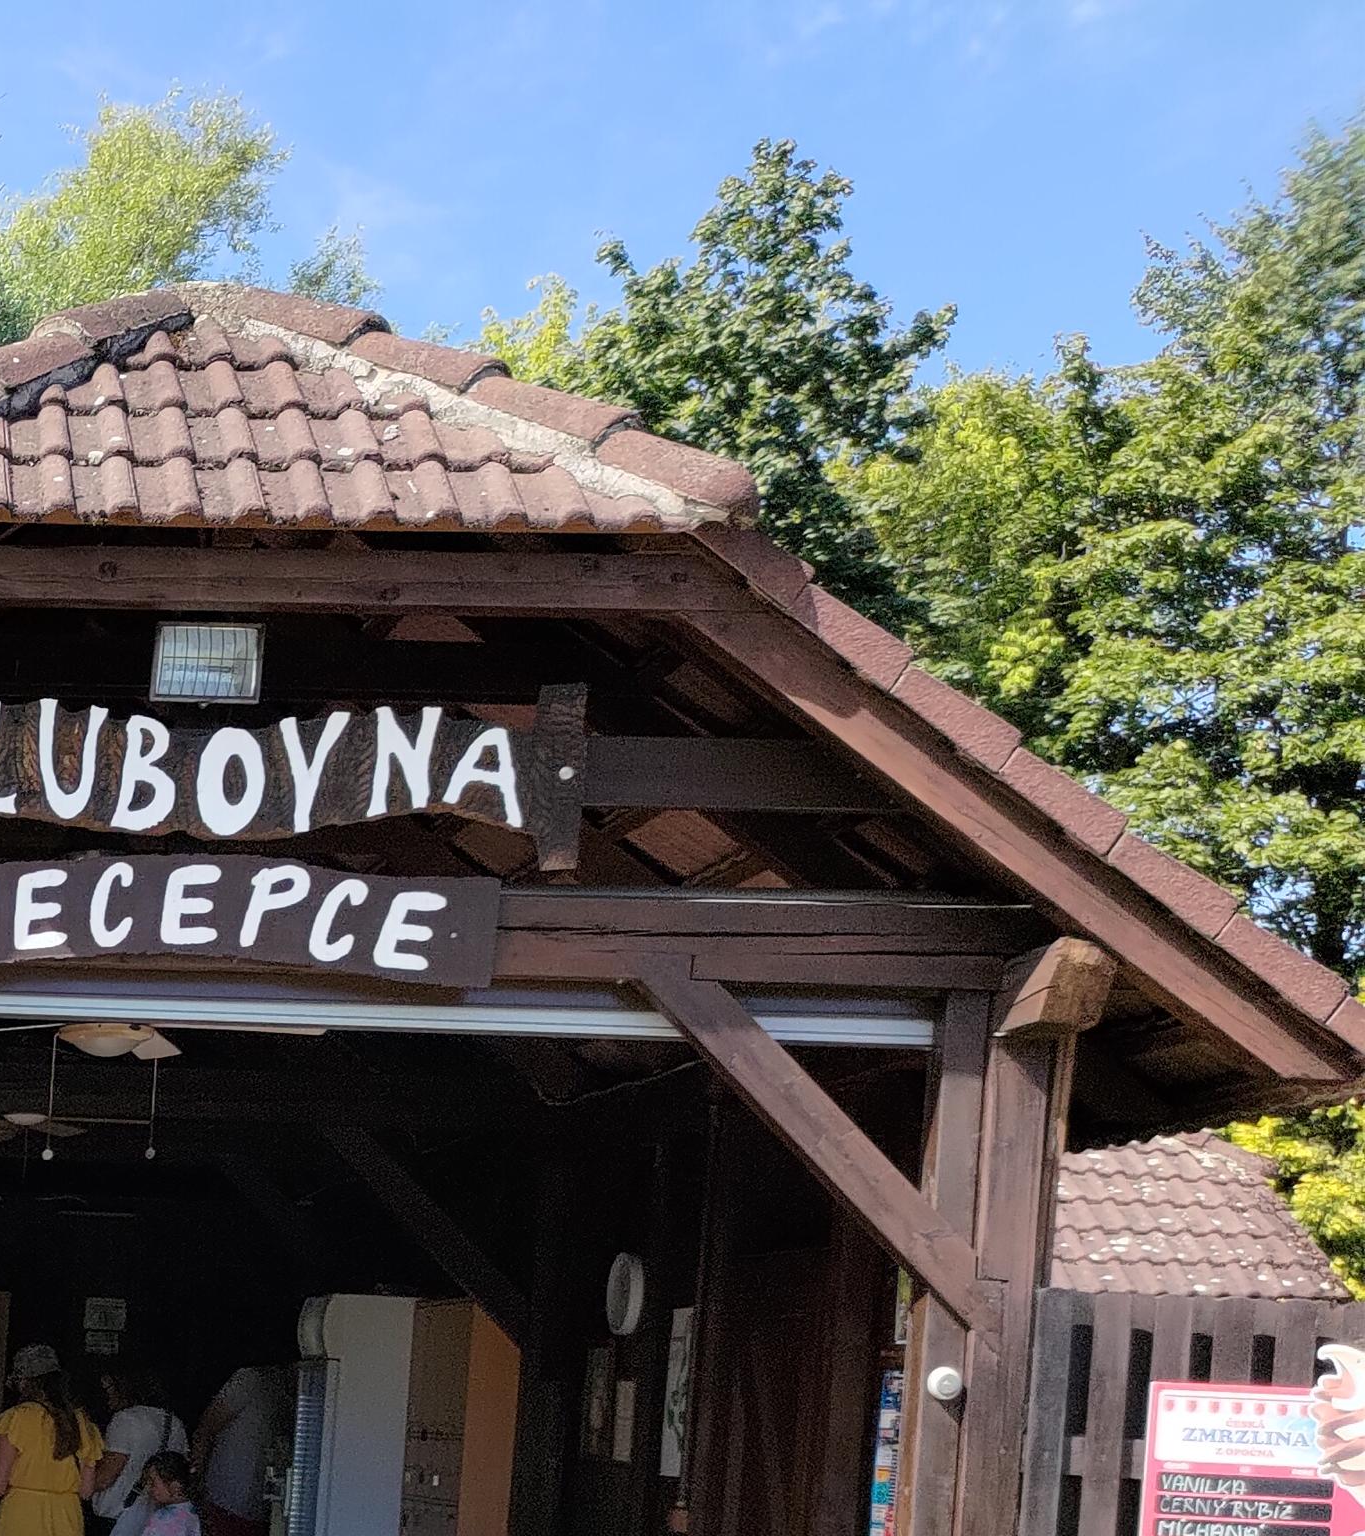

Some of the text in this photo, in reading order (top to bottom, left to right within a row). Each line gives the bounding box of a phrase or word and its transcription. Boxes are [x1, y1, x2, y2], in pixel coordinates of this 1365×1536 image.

[1181, 1427, 1310, 1448] ZMRZLINA
[1215, 1447, 1225, 1456] Z
[1161, 1474, 1247, 1495] VANILKA
[1159, 1493, 1294, 1520] ČERNÝ RYBÍZ
